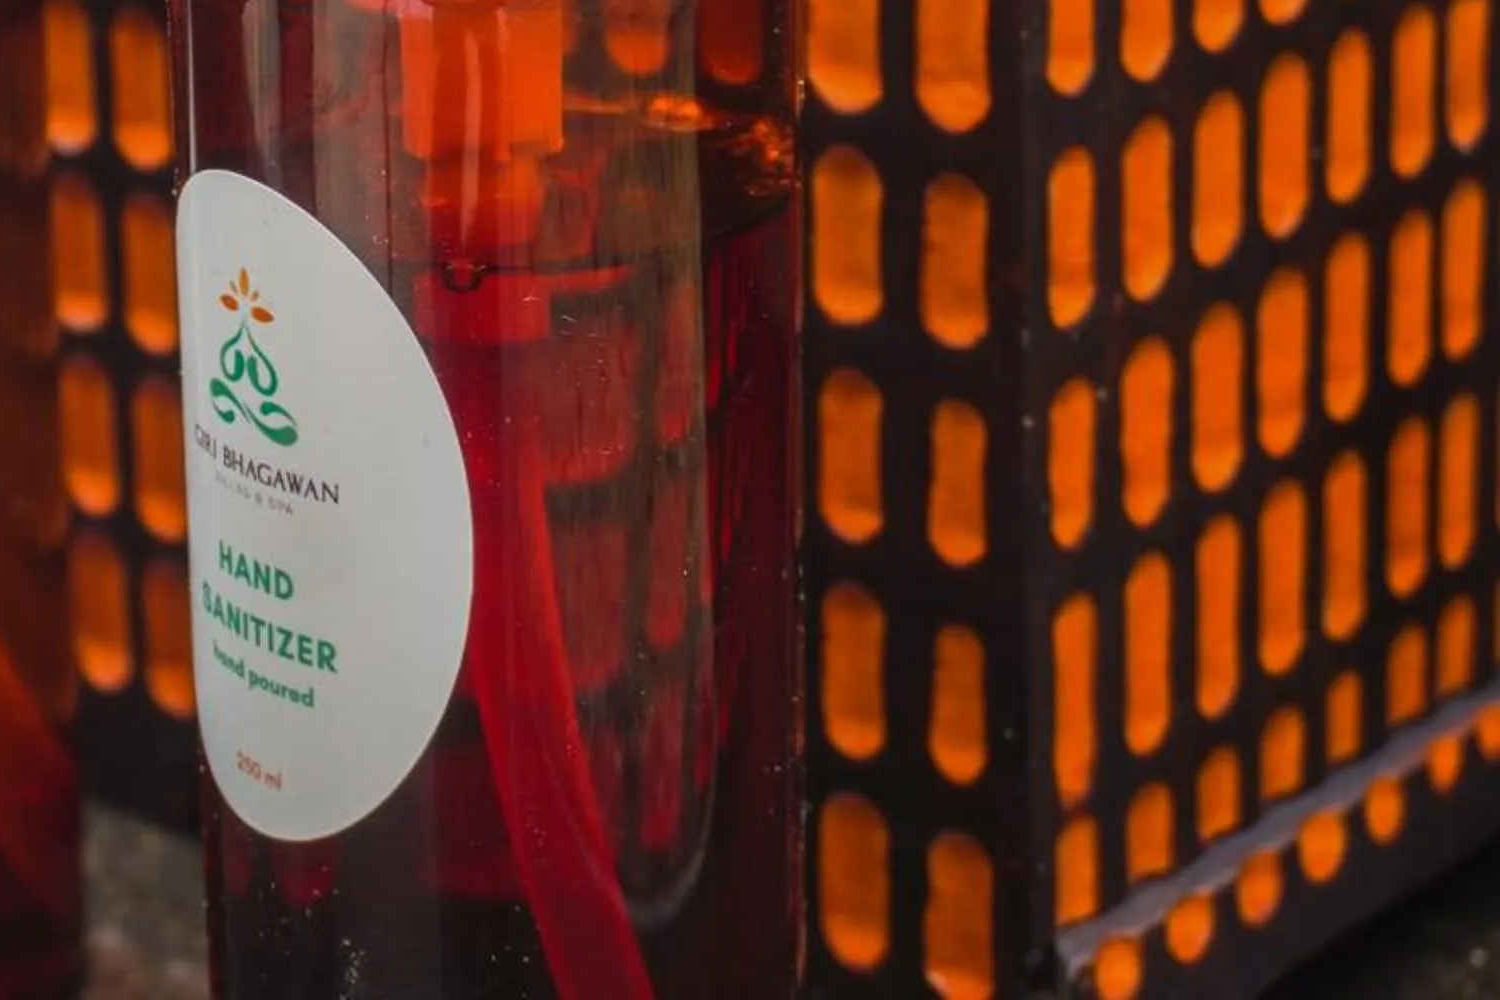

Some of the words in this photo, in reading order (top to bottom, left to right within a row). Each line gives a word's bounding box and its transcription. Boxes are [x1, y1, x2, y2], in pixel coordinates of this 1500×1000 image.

[223, 446, 340, 504] BHAGAWAN
[219, 540, 294, 600] HAND
[202, 581, 337, 674] SANITIZER
[213, 639, 245, 678] hand
[249, 669, 315, 708] poured
[236, 751, 262, 780] 250
[265, 767, 283, 791] ml
